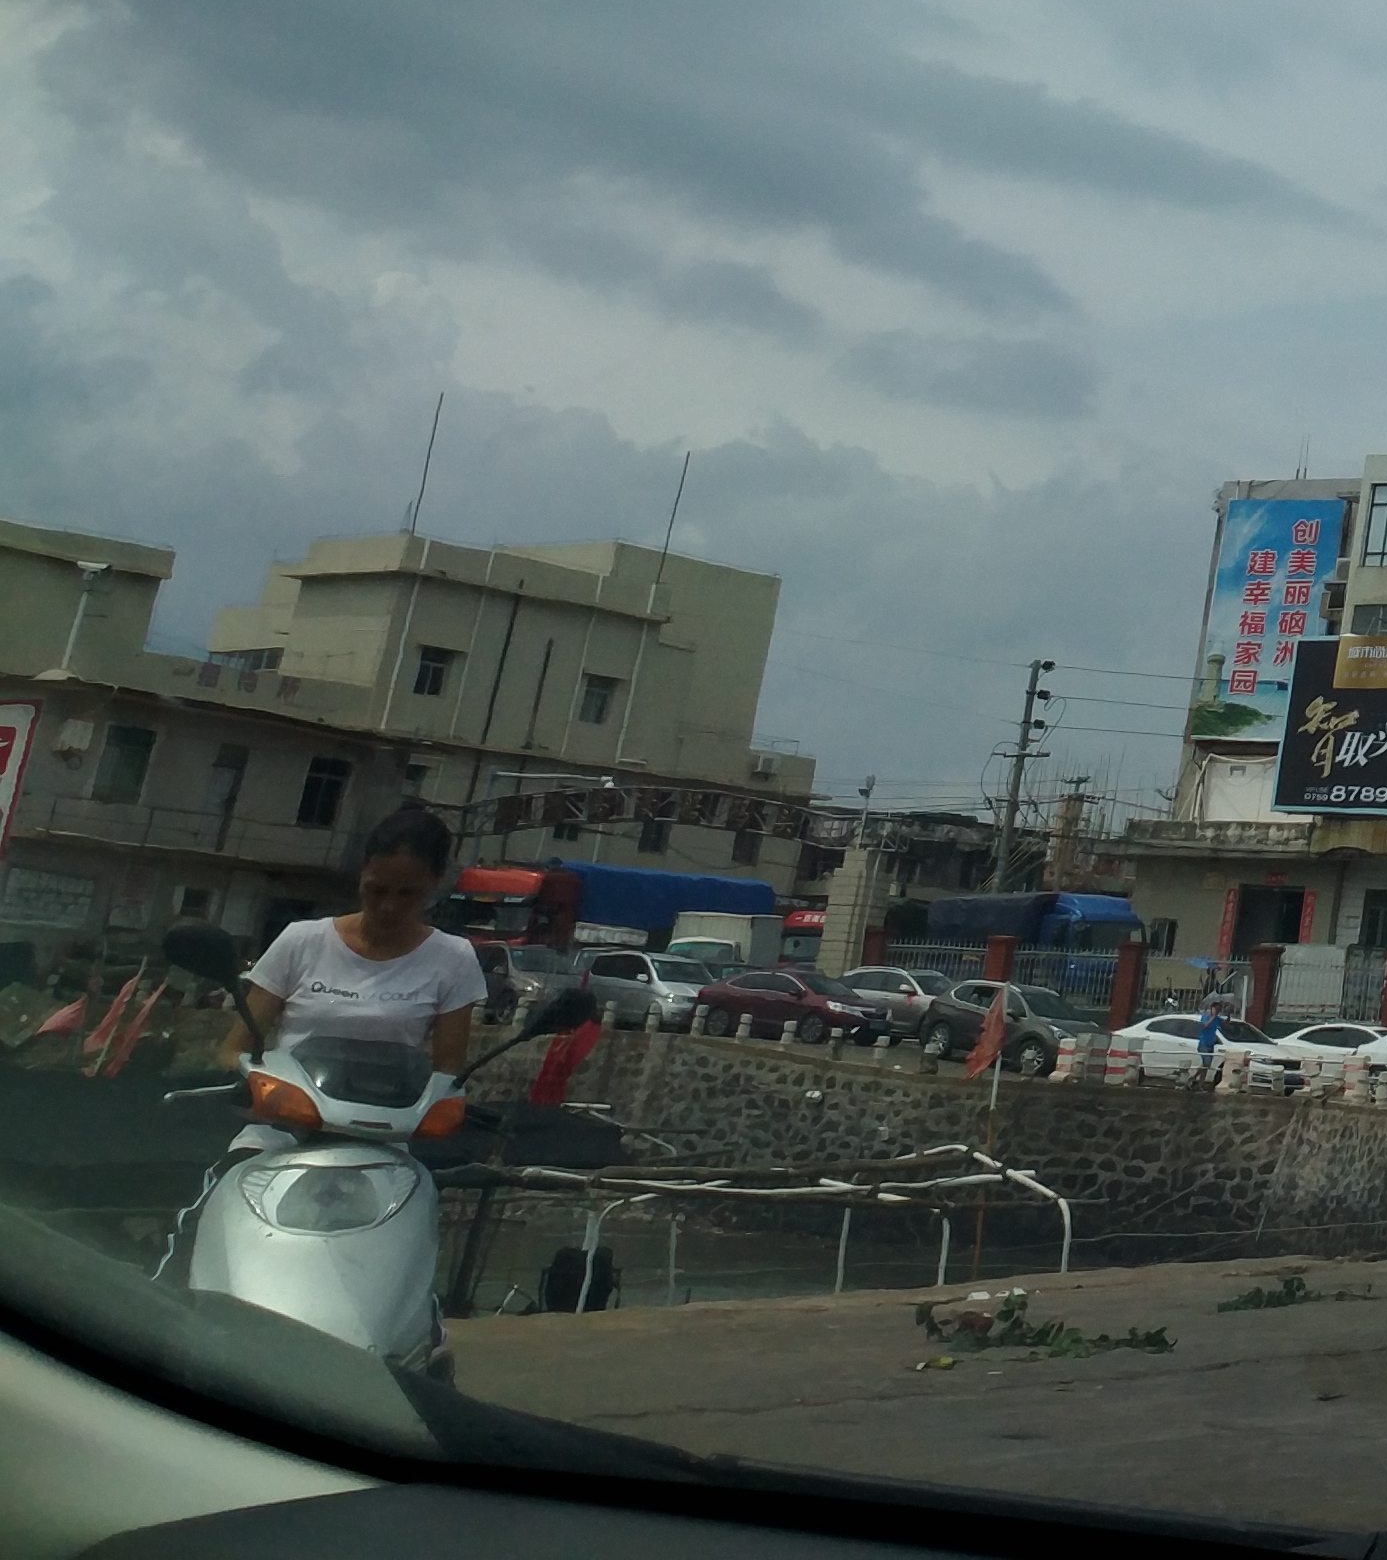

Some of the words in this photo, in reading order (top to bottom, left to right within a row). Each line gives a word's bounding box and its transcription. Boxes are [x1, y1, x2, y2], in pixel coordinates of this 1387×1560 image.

[1228, 548, 1278, 695] 建幸福家园
